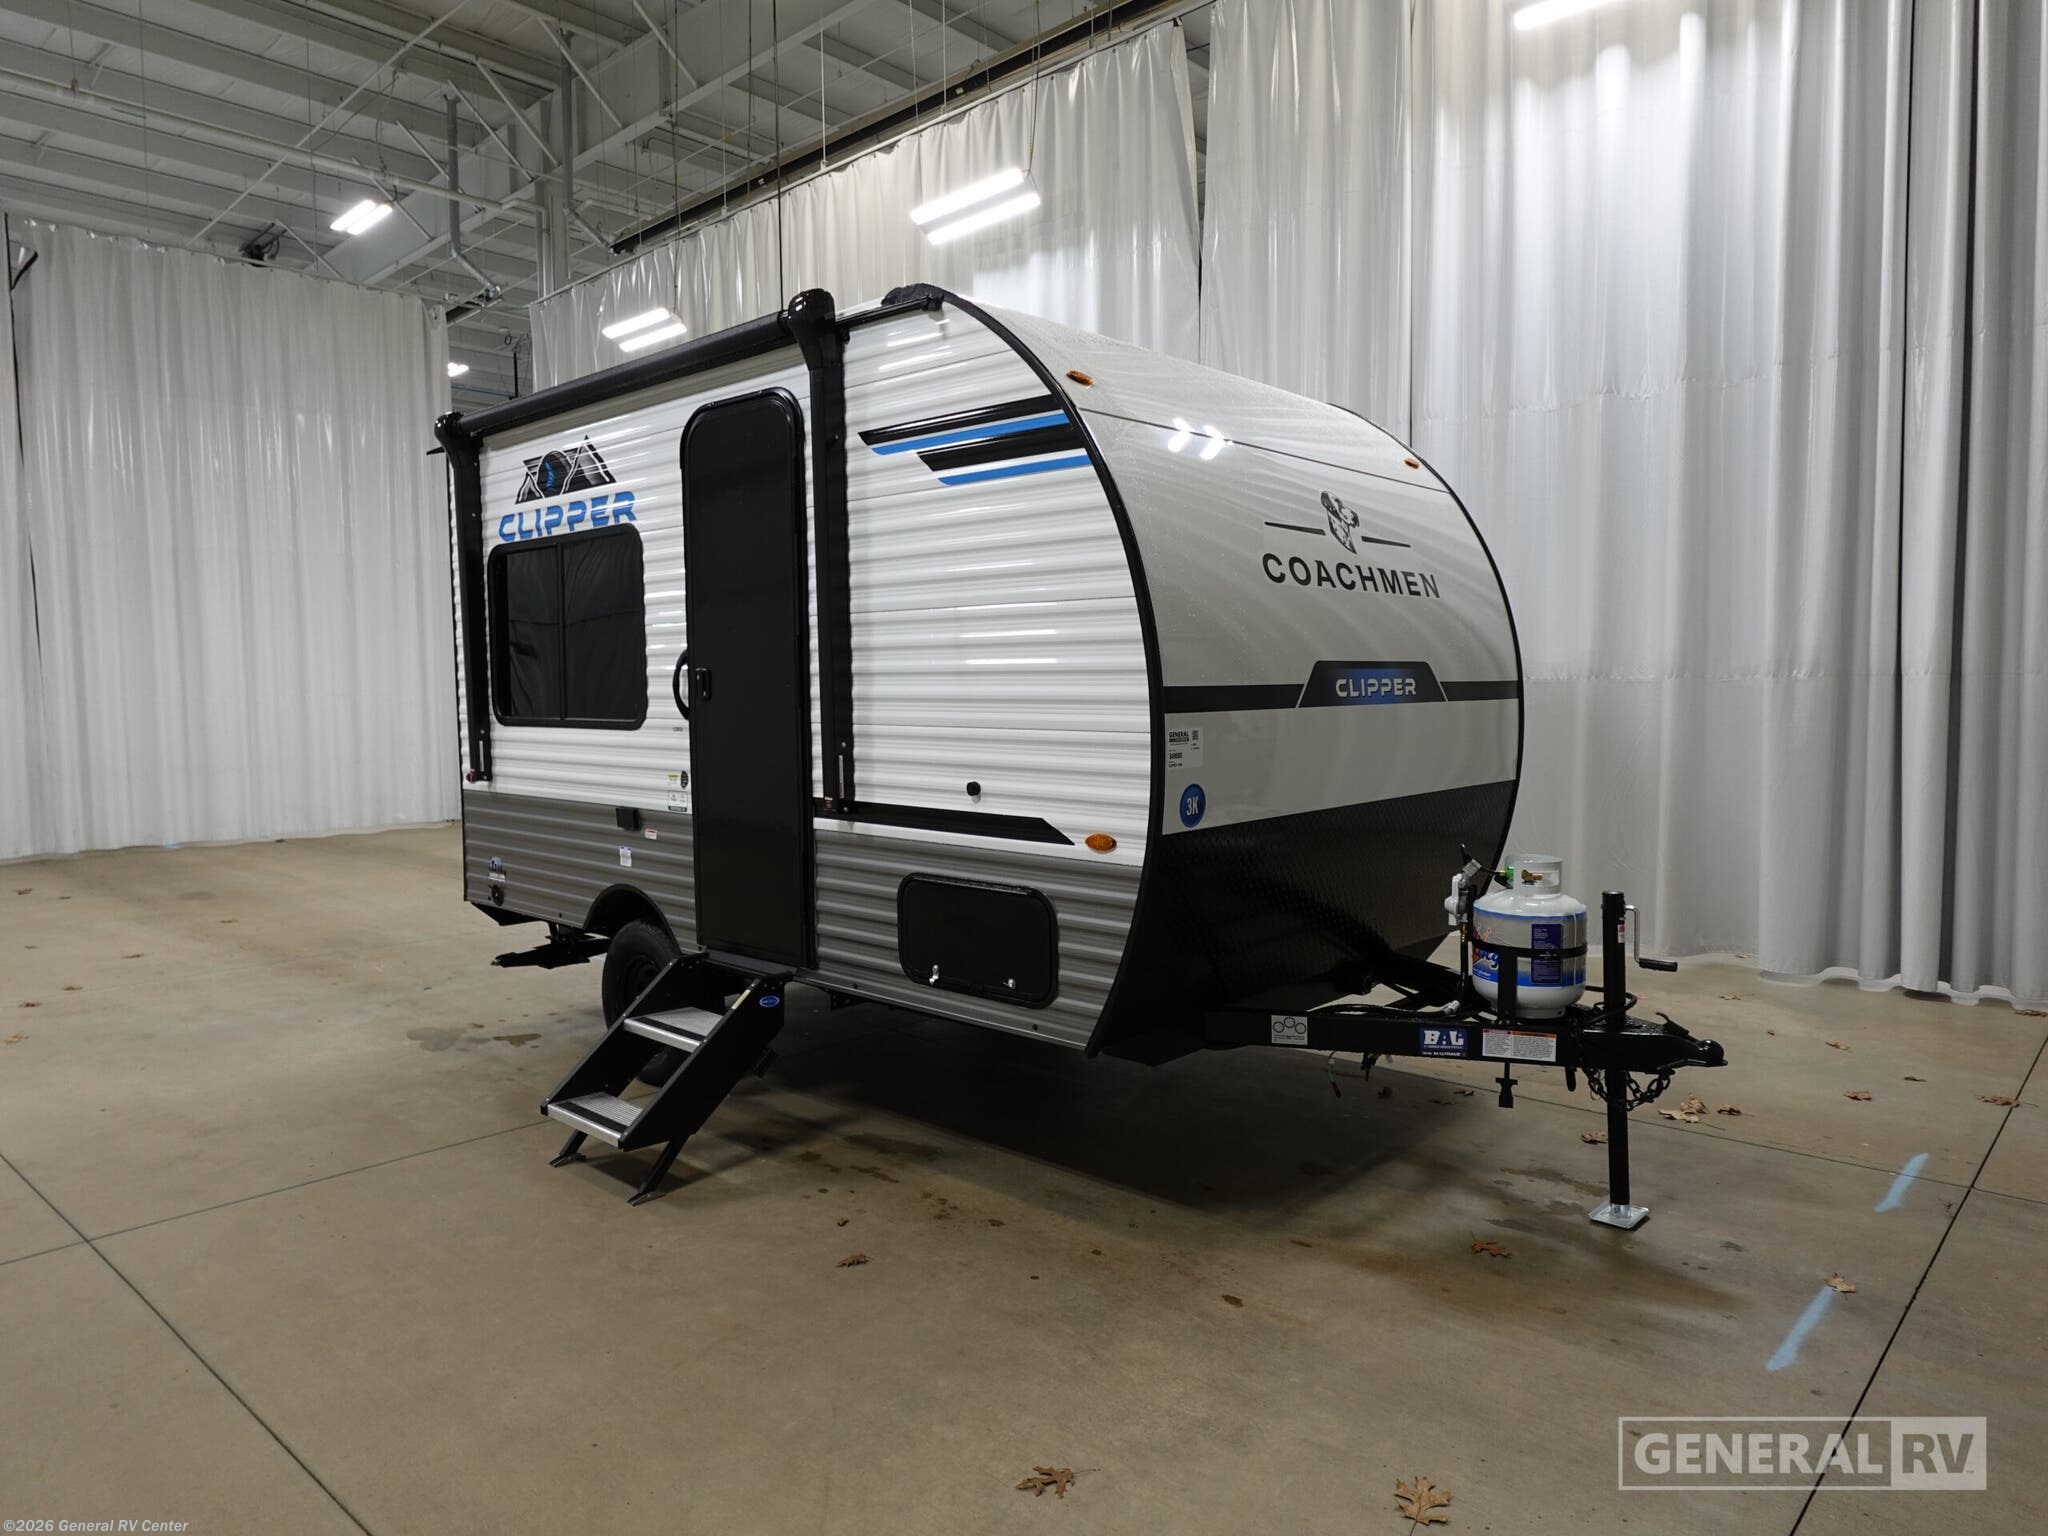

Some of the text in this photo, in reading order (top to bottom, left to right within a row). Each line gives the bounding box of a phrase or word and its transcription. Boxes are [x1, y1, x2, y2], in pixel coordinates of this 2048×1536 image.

[498, 490, 637, 542] CLIPPER
[1262, 553, 1440, 598] COACHMEN
[1335, 678, 1417, 697] CLIPPER
[1186, 796, 1199, 816] 3K
